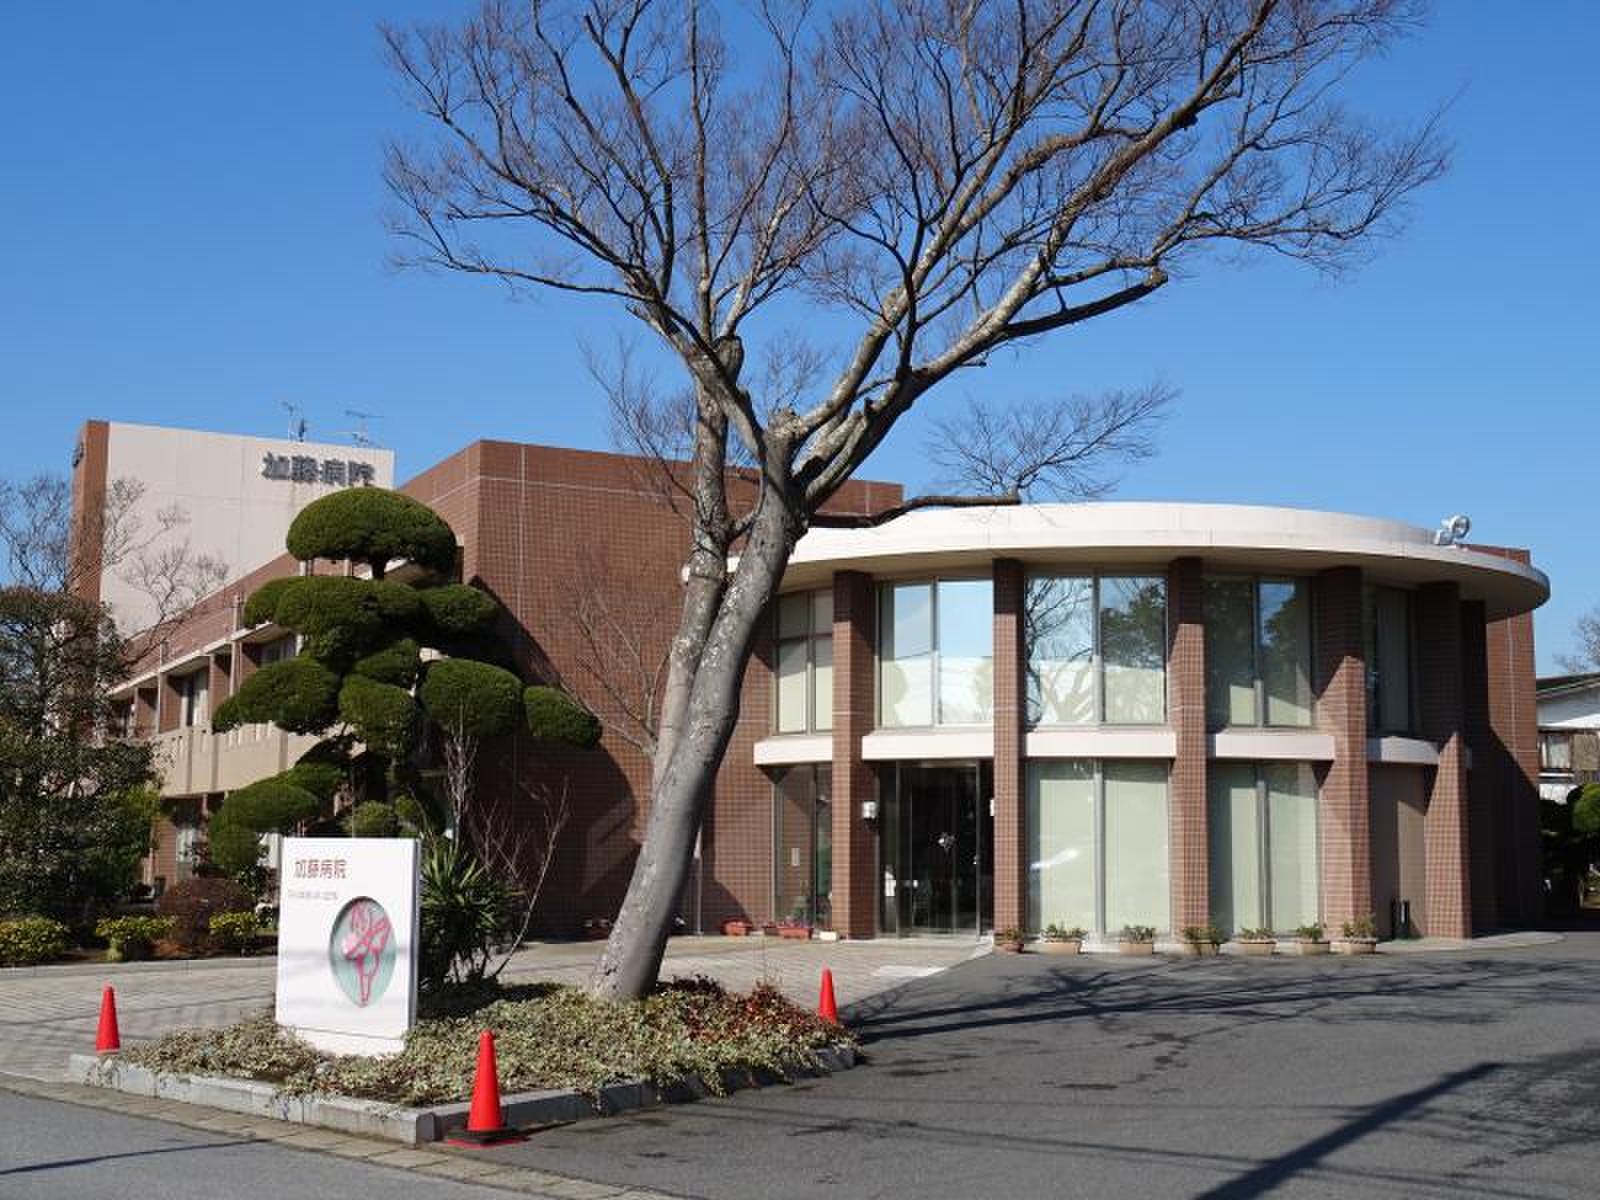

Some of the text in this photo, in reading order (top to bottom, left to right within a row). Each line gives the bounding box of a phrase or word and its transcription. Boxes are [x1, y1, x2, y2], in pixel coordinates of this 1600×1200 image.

[262, 452, 375, 486] 加藤病院
[294, 859, 347, 879] 加藤病院
